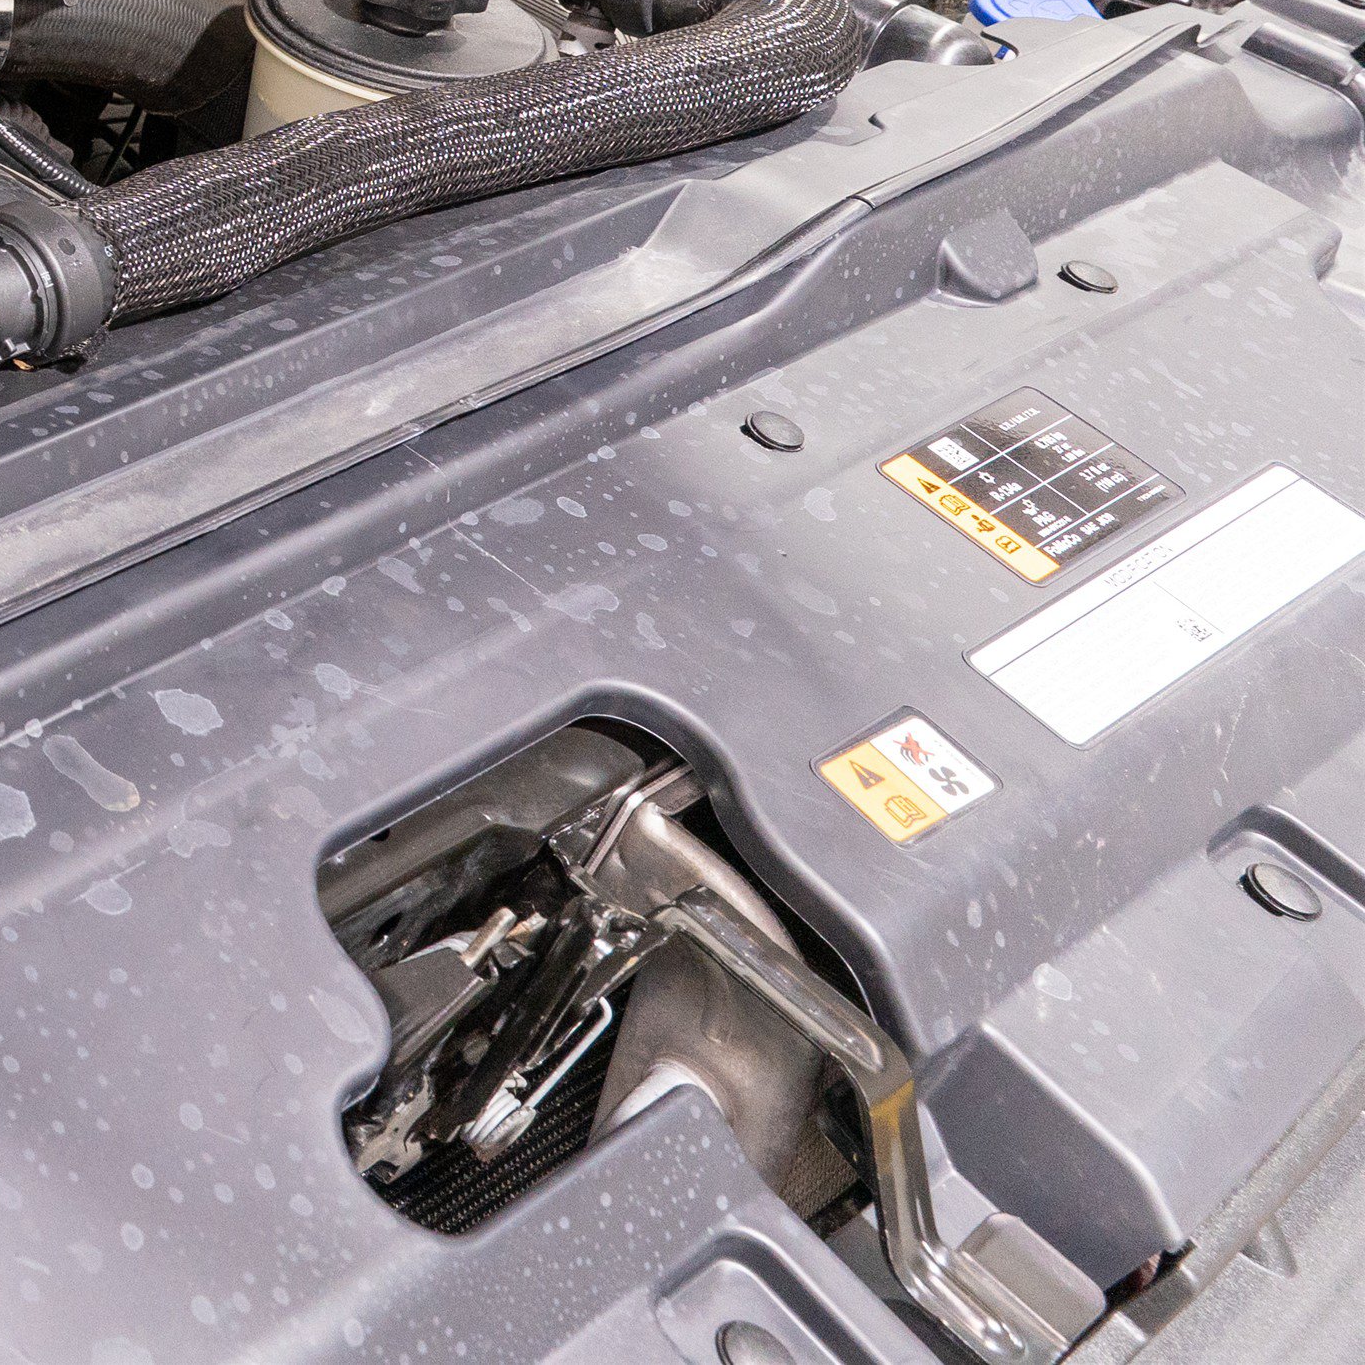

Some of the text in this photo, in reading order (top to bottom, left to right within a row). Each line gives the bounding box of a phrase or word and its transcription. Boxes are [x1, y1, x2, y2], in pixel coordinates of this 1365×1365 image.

[989, 482, 1023, 502] R-134a
[1032, 511, 1057, 528] PAG
[1043, 534, 1083, 558] FoMoCo
